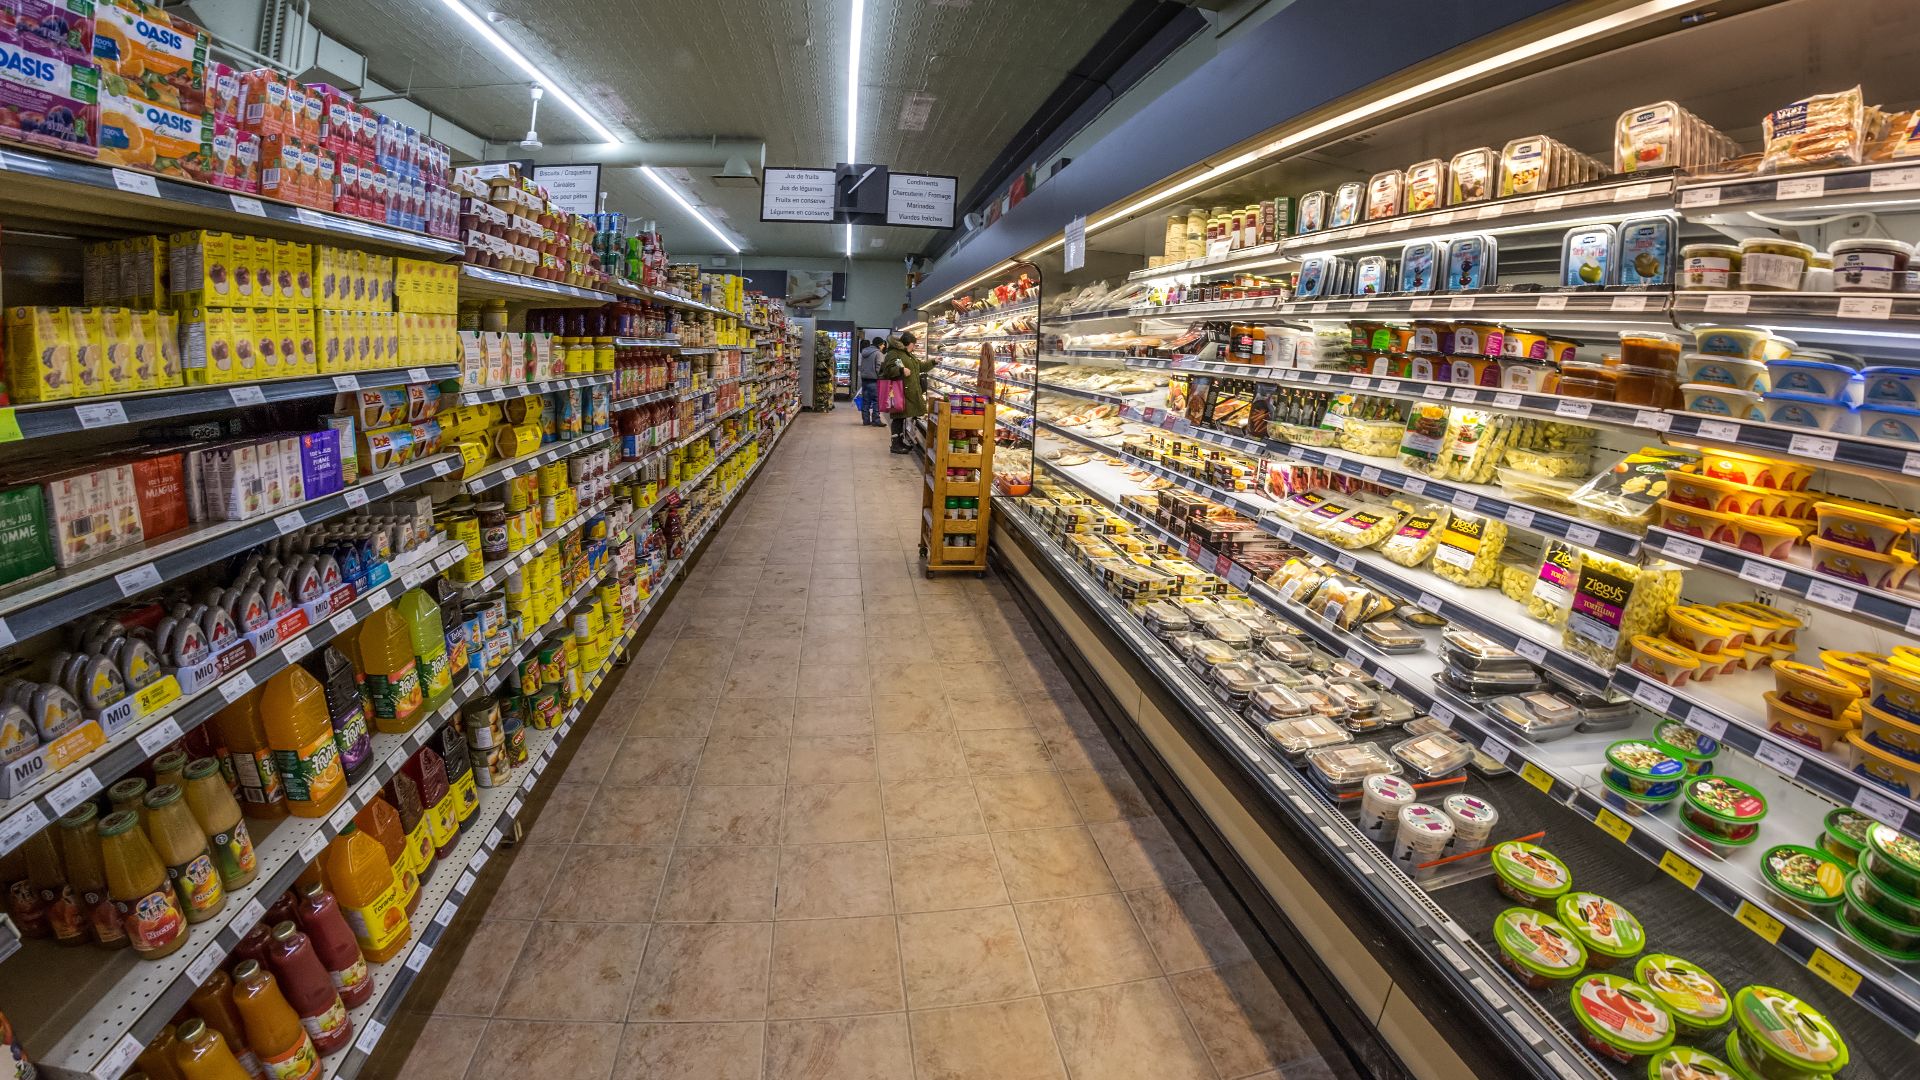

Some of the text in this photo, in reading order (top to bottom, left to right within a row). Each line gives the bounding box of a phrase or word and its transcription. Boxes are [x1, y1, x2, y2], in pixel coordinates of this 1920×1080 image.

[136, 21, 182, 49] OASIS
[147, 108, 192, 133] OASIS
[564, 169, 592, 177] Craquelins
[906, 179, 939, 187] Condiments
[892, 189, 924, 198] Charcuterie
[927, 191, 952, 200] Fromage
[770, 208, 795, 216] Légumes
[906, 202, 935, 210] Marinades
[898, 213, 920, 221] Viandes
[363, 391, 382, 403] Dole
[373, 436, 391, 447] Dole
[145, 483, 179, 499] MANGUE
[17, 512, 33, 524] JUS
[0, 524, 38, 545] OMME
[1584, 576, 1624, 602] Ziggy's
[314, 600, 328, 615] MiO
[1583, 599, 1616, 619] TORTELLINI
[258, 628, 275, 645] MiO
[193, 654, 231, 682] MiO 24
[106, 694, 150, 725] MiO 24
[14, 754, 44, 782] MiO
[194, 883, 219, 902] Nectar
[145, 919, 177, 941] Nectar
